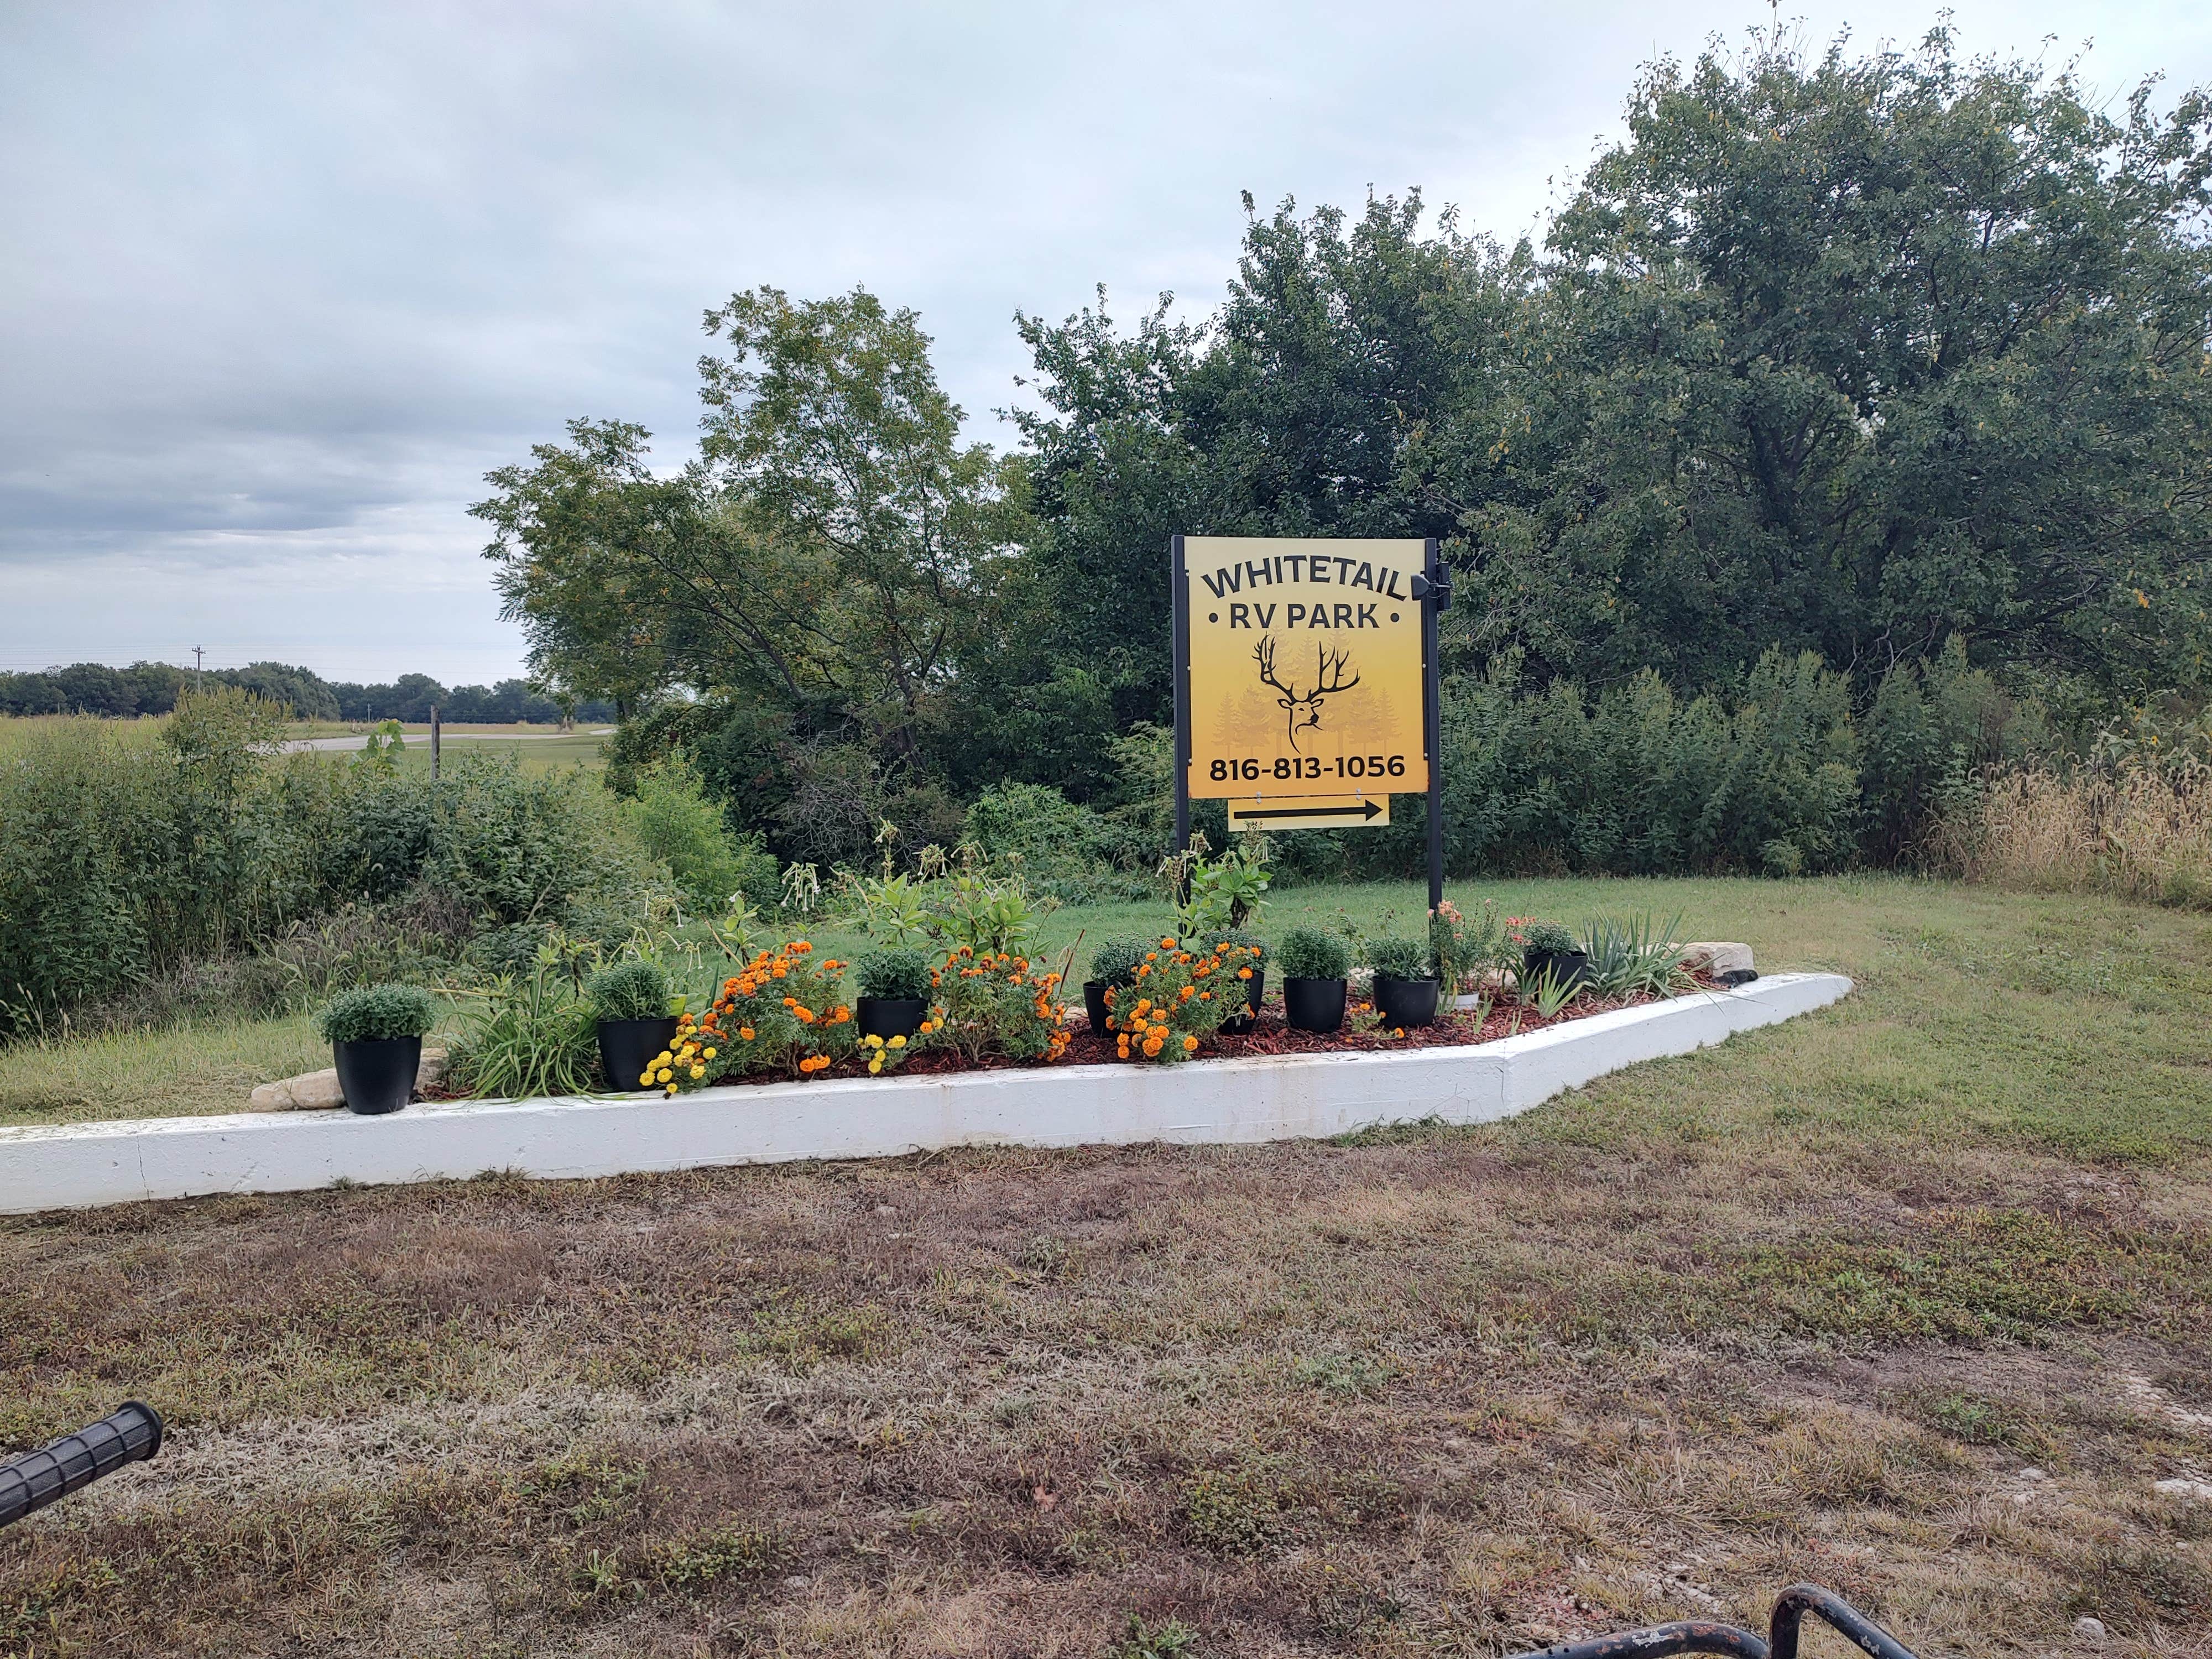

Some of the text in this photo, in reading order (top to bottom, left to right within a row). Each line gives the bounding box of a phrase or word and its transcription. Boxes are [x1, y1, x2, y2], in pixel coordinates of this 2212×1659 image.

[1201, 555, 1407, 601] WHITETAIL
[1230, 603, 1380, 629] RV PARK
[1209, 755, 1405, 781] 816-813-1056
